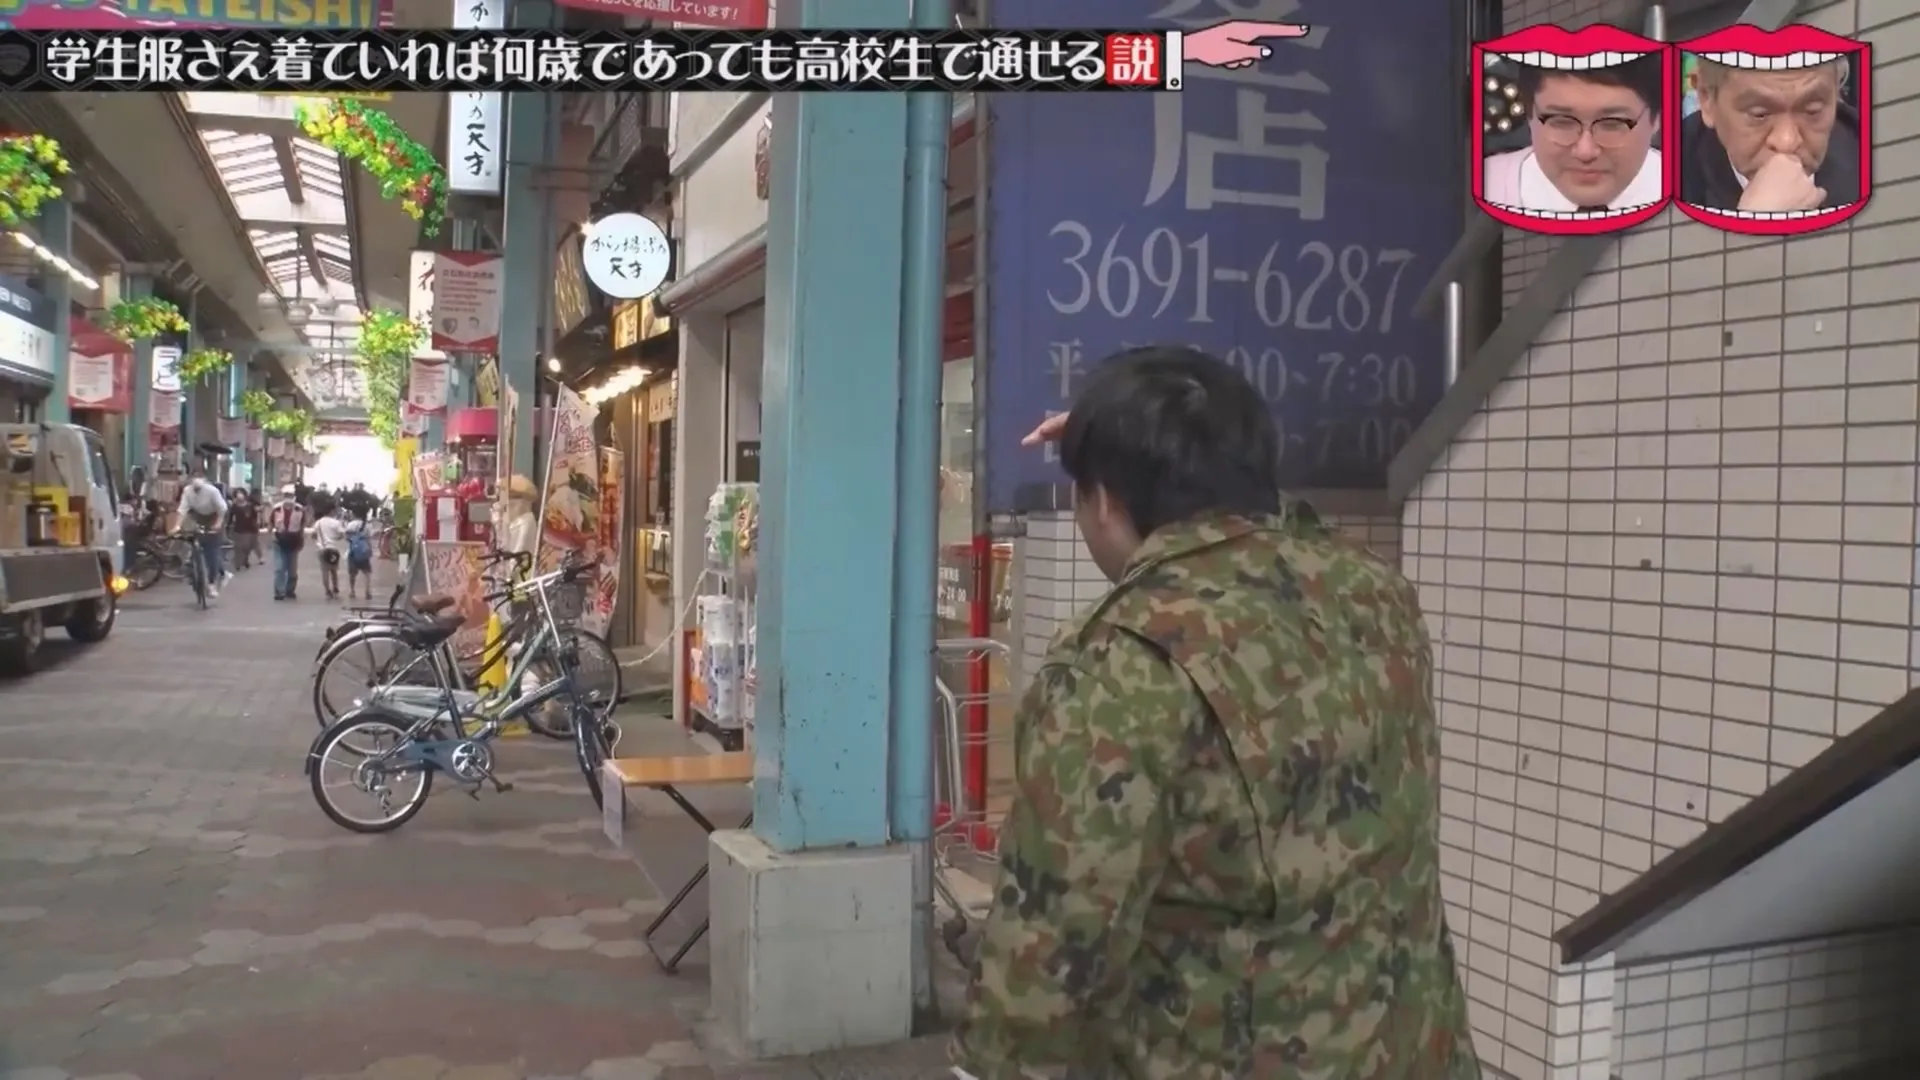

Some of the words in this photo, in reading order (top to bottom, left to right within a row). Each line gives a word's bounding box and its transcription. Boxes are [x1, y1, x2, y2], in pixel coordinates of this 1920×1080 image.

[126, 0, 372, 28] EISHI
[1142, 0, 1332, 221] 店
[1046, 219, 1417, 333] 3691-6287
